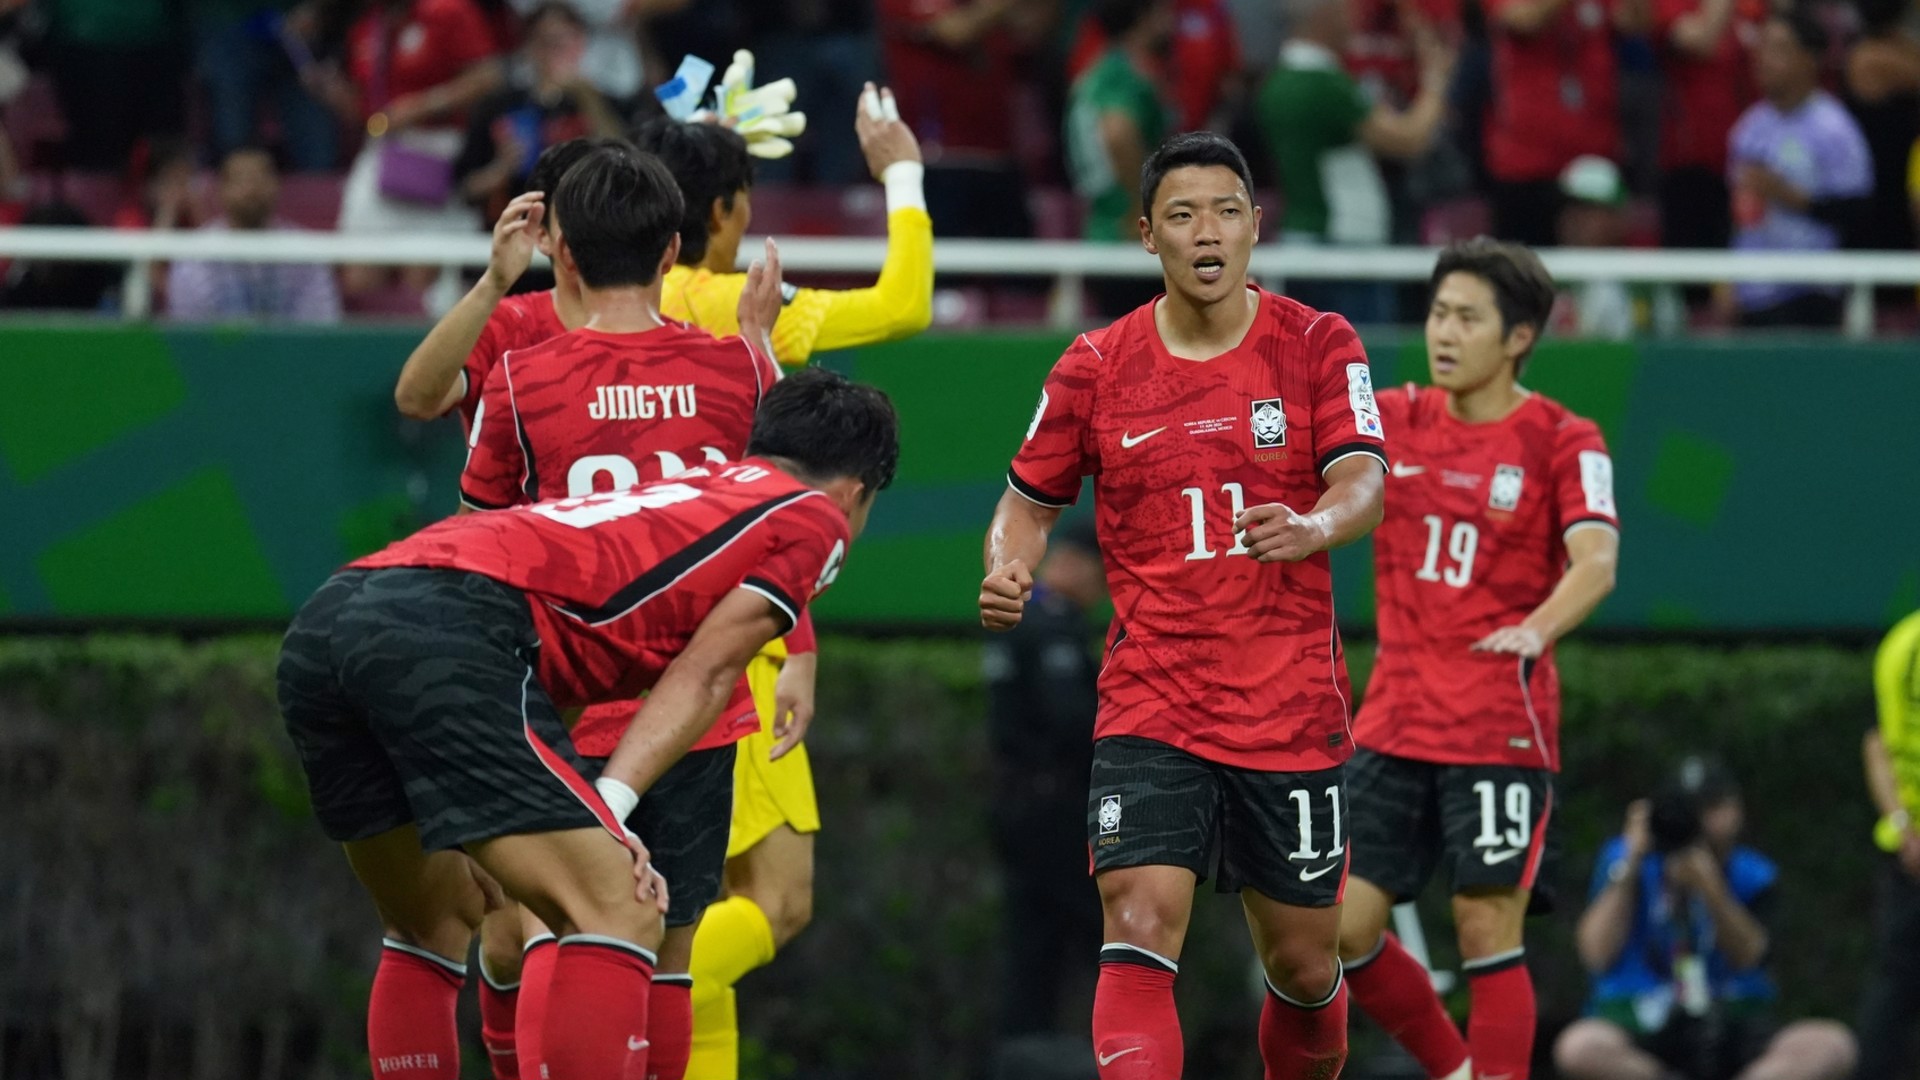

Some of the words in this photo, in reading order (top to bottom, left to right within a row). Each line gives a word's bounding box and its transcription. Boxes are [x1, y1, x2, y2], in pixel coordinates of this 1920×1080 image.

[587, 384, 697, 420] JINGYU
[1254, 451, 1288, 462] KOREA
[1181, 482, 1252, 562] 11
[1415, 514, 1479, 588] 19
[1288, 785, 1344, 861] 11
[1472, 780, 1531, 849] 19
